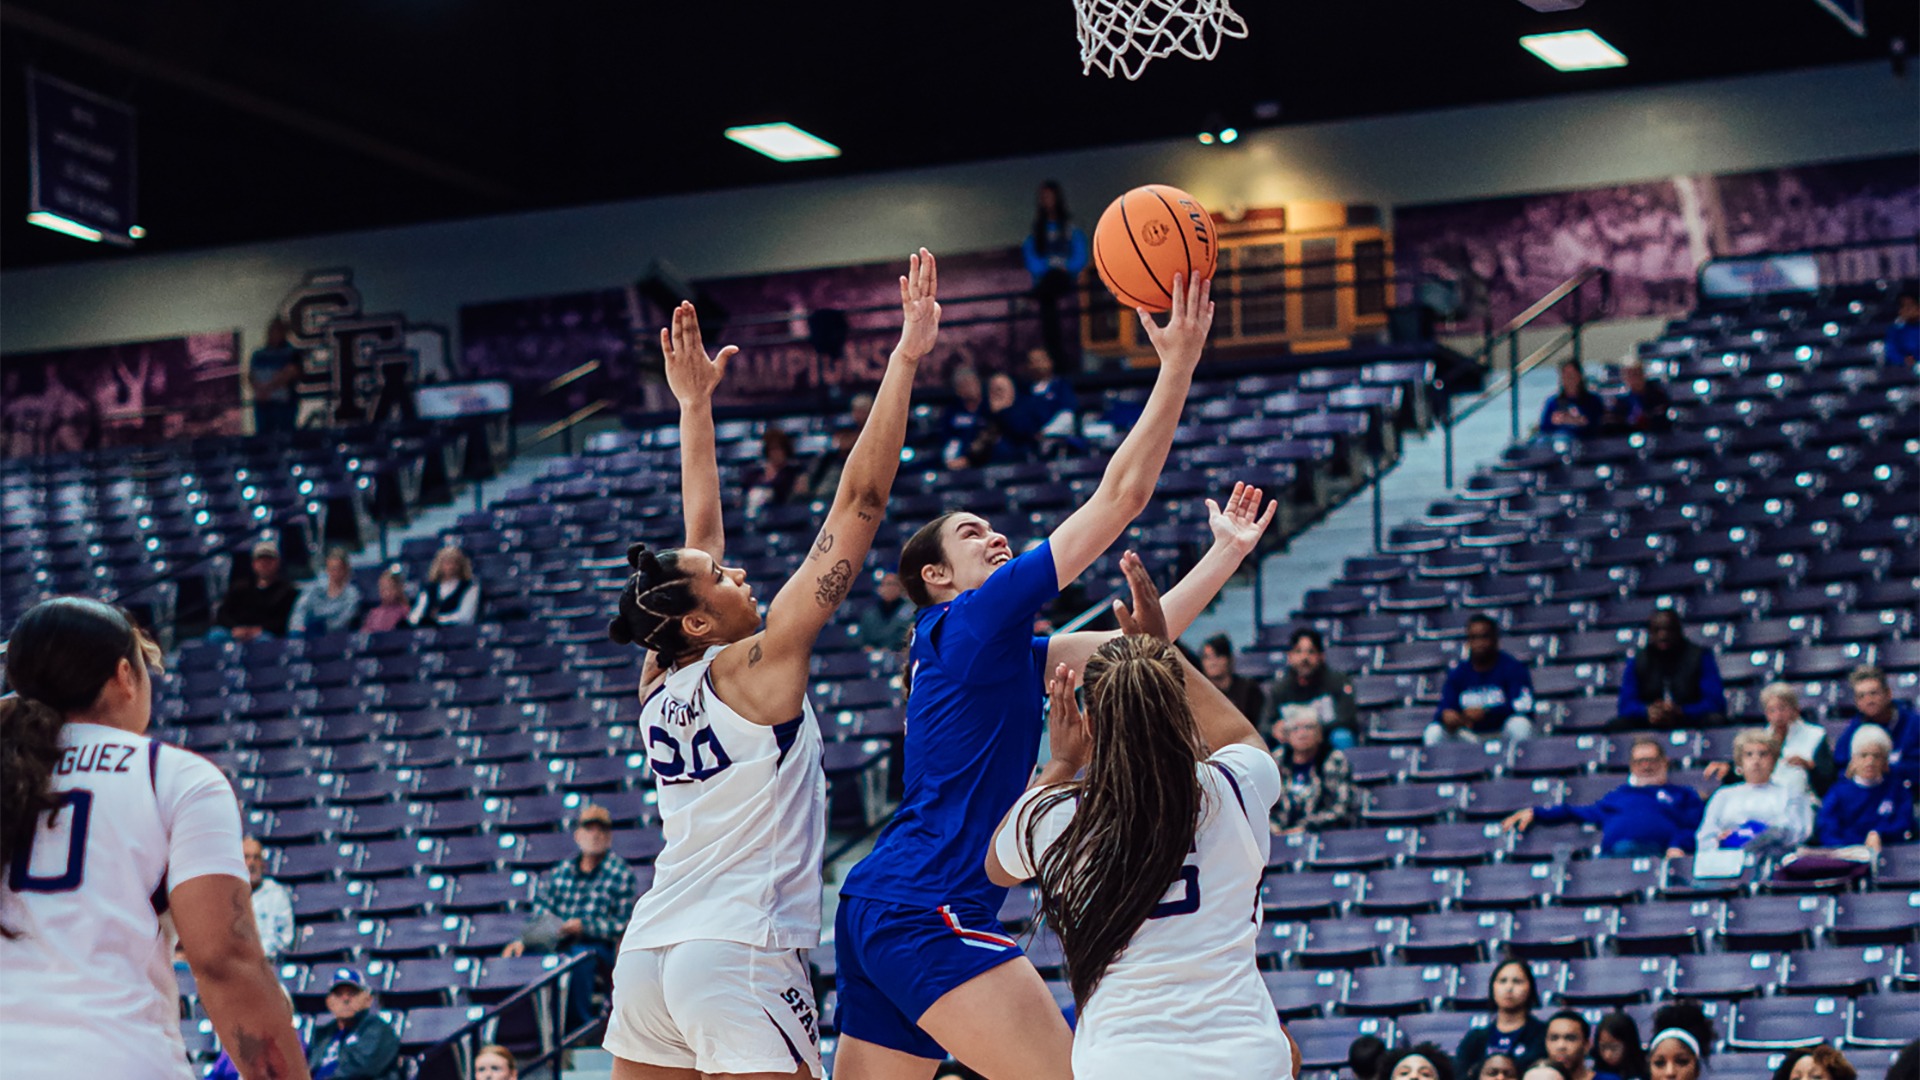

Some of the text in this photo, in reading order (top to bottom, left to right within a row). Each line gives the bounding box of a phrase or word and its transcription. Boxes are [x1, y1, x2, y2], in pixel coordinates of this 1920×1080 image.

[56, 743, 138, 775] GUEZ
[649, 725, 733, 786] 20
[780, 987, 818, 1047] SFA
